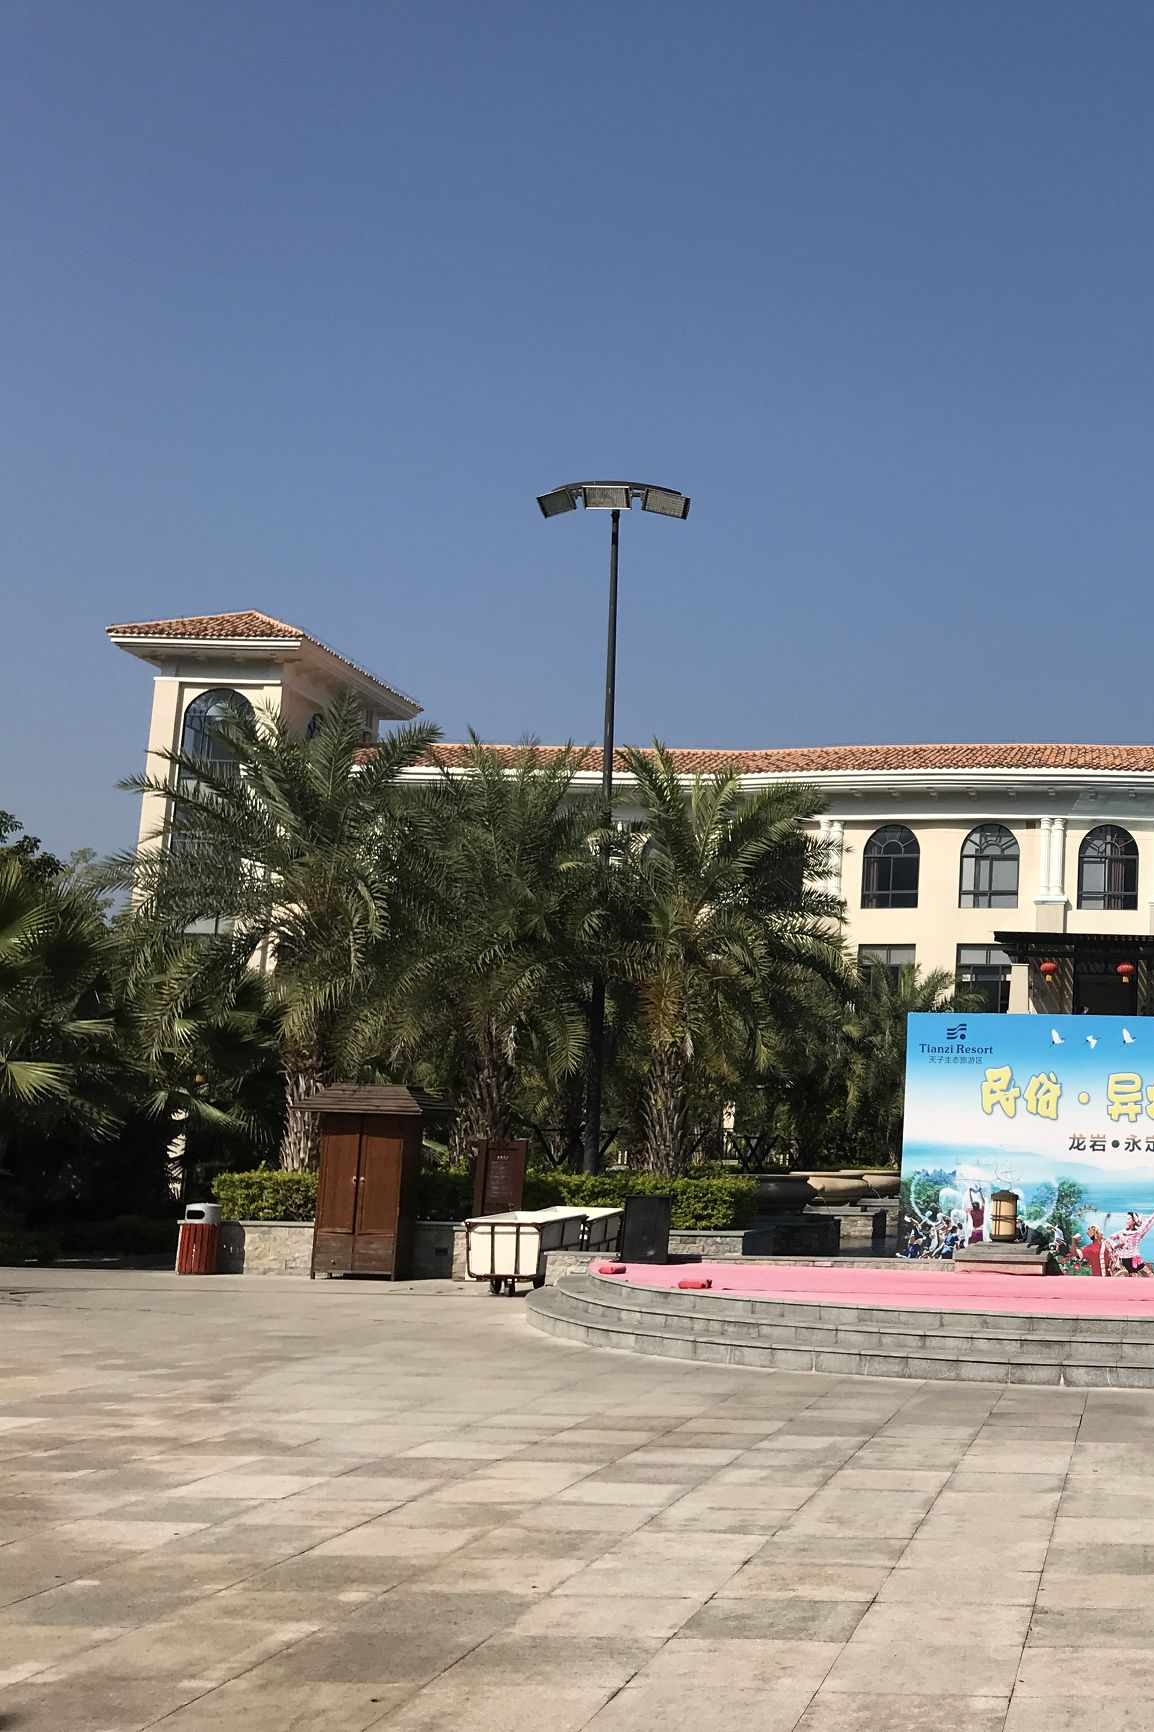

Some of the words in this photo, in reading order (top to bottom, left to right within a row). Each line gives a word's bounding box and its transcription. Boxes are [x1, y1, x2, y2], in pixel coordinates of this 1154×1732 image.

[919, 1043, 954, 1053] Tianzi
[956, 1044, 994, 1054] Resort
[928, 1056, 983, 1064] 天子生态旅游区
